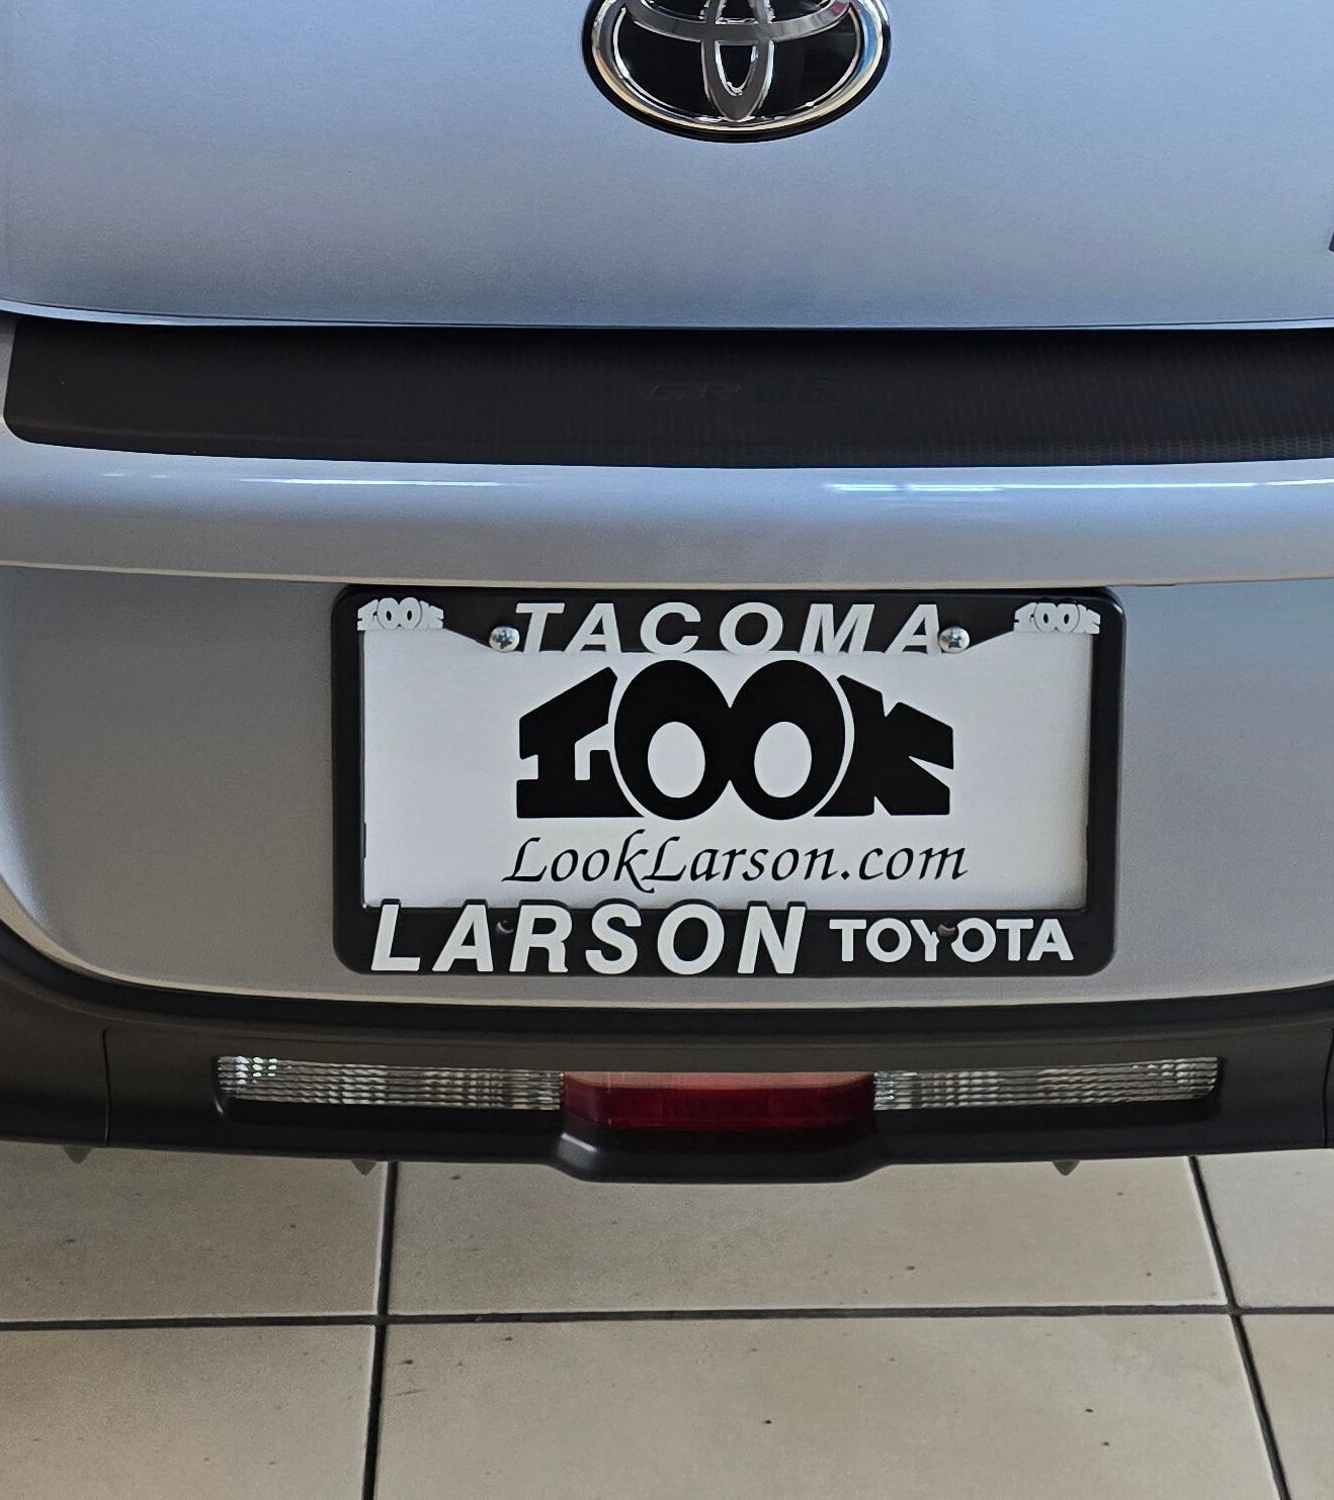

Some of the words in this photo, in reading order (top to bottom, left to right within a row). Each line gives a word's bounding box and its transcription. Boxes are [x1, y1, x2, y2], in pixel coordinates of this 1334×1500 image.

[516, 601, 944, 654] TACOMA
[516, 658, 955, 821] LOOK
[501, 828, 969, 894] LookLarson.com
[370, 900, 807, 975] LARSON
[828, 917, 1075, 963] TOYOTA
